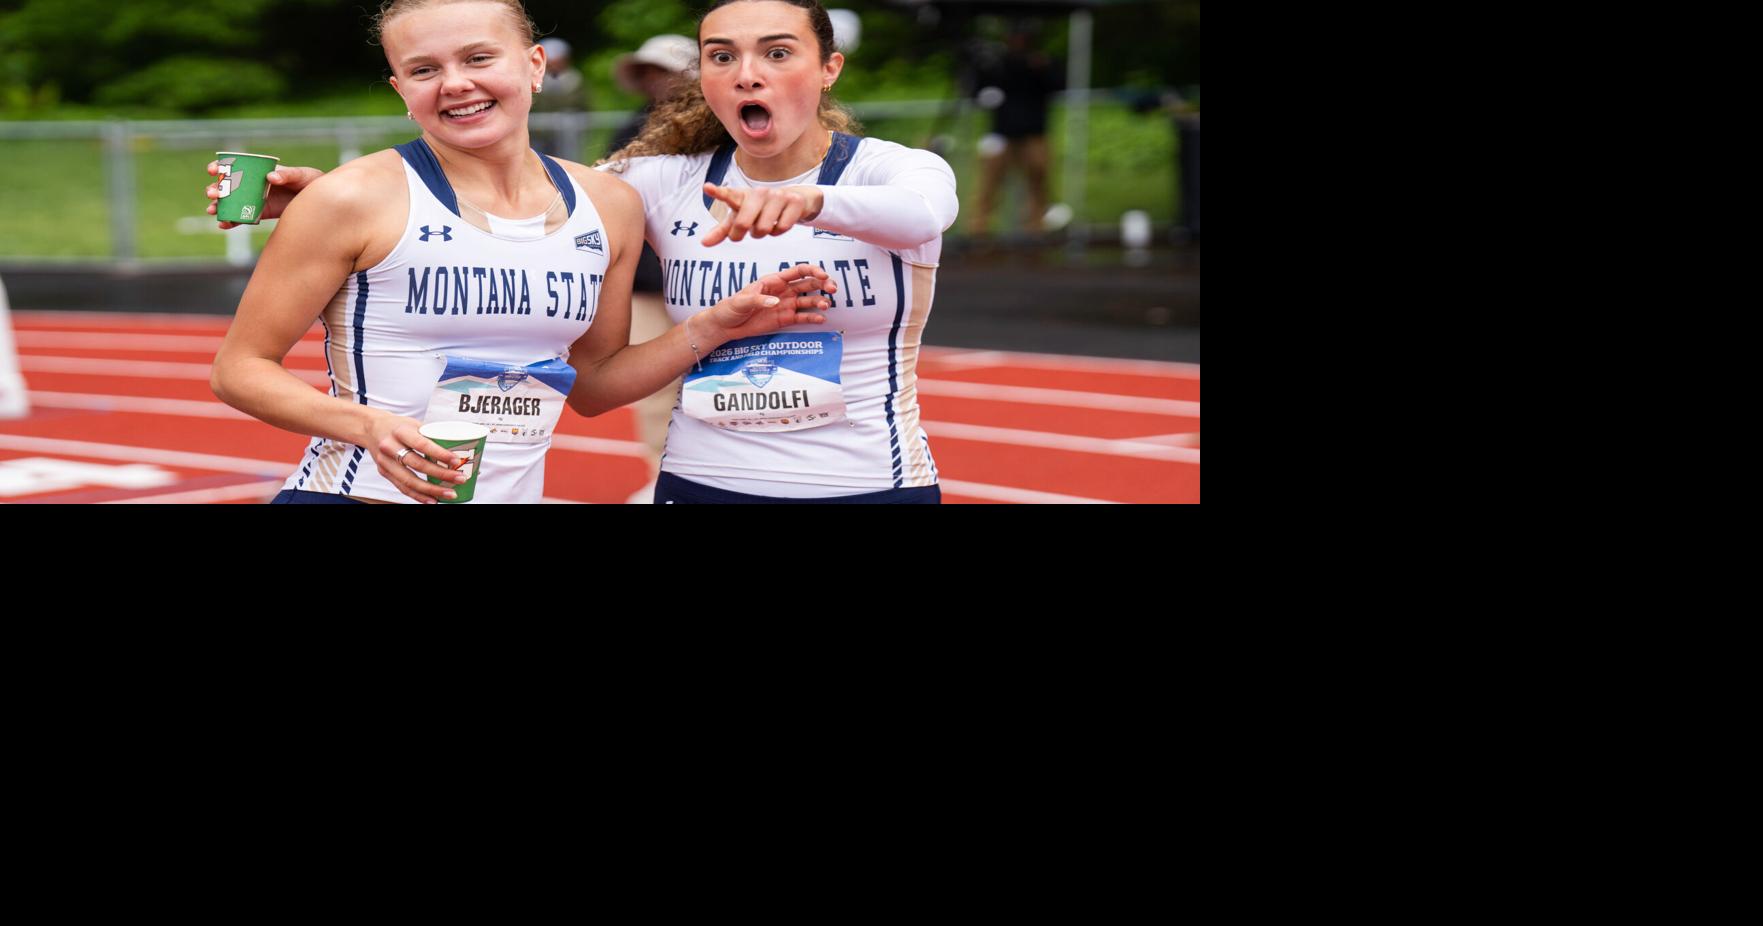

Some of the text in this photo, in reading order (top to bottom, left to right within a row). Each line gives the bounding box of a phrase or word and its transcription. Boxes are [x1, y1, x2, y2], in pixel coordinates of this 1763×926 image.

[405, 266, 603, 322] MONTANA STAT
[710, 341, 823, 358] 2026 BIG SKY OUTDOOR
[458, 394, 541, 416] BJERAGER
[713, 390, 810, 412] GANDOLFI
